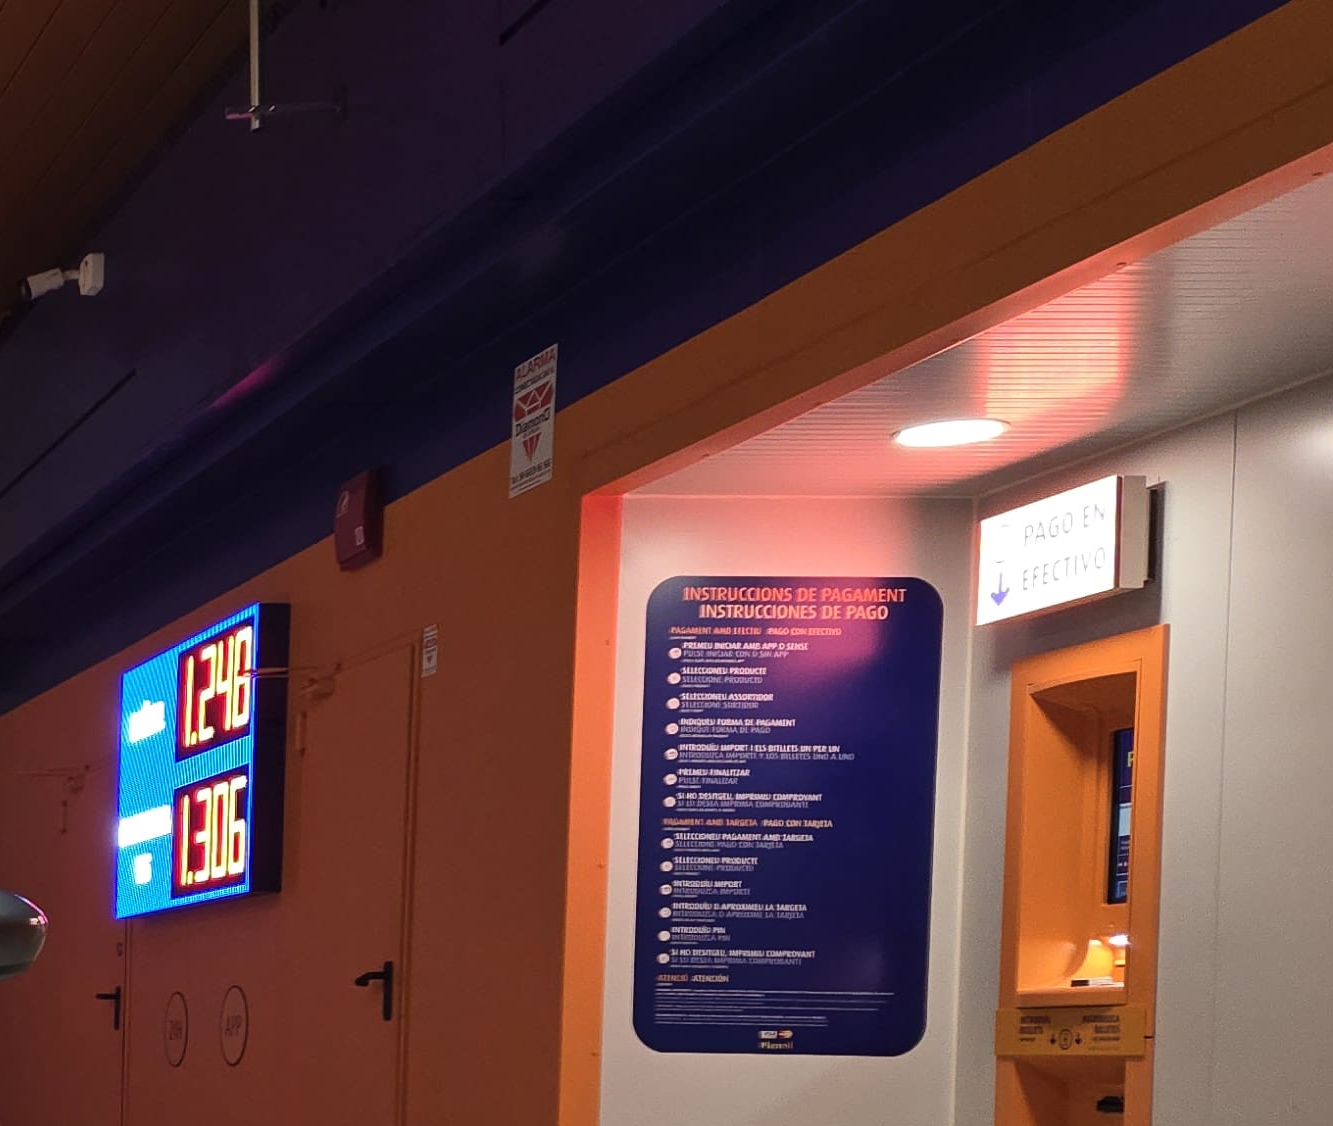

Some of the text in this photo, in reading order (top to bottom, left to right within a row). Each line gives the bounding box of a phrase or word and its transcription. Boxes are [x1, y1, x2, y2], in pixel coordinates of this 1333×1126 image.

[1024, 503, 1106, 547] PAGO EN
[1022, 547, 1106, 591] EFECTIVO
[683, 587, 907, 603] INSTRUCCIONS DE PAGAMENT
[699, 604, 889, 620] INSTRUCCIONES DE PAGO
[180, 774, 248, 886] 1.306
